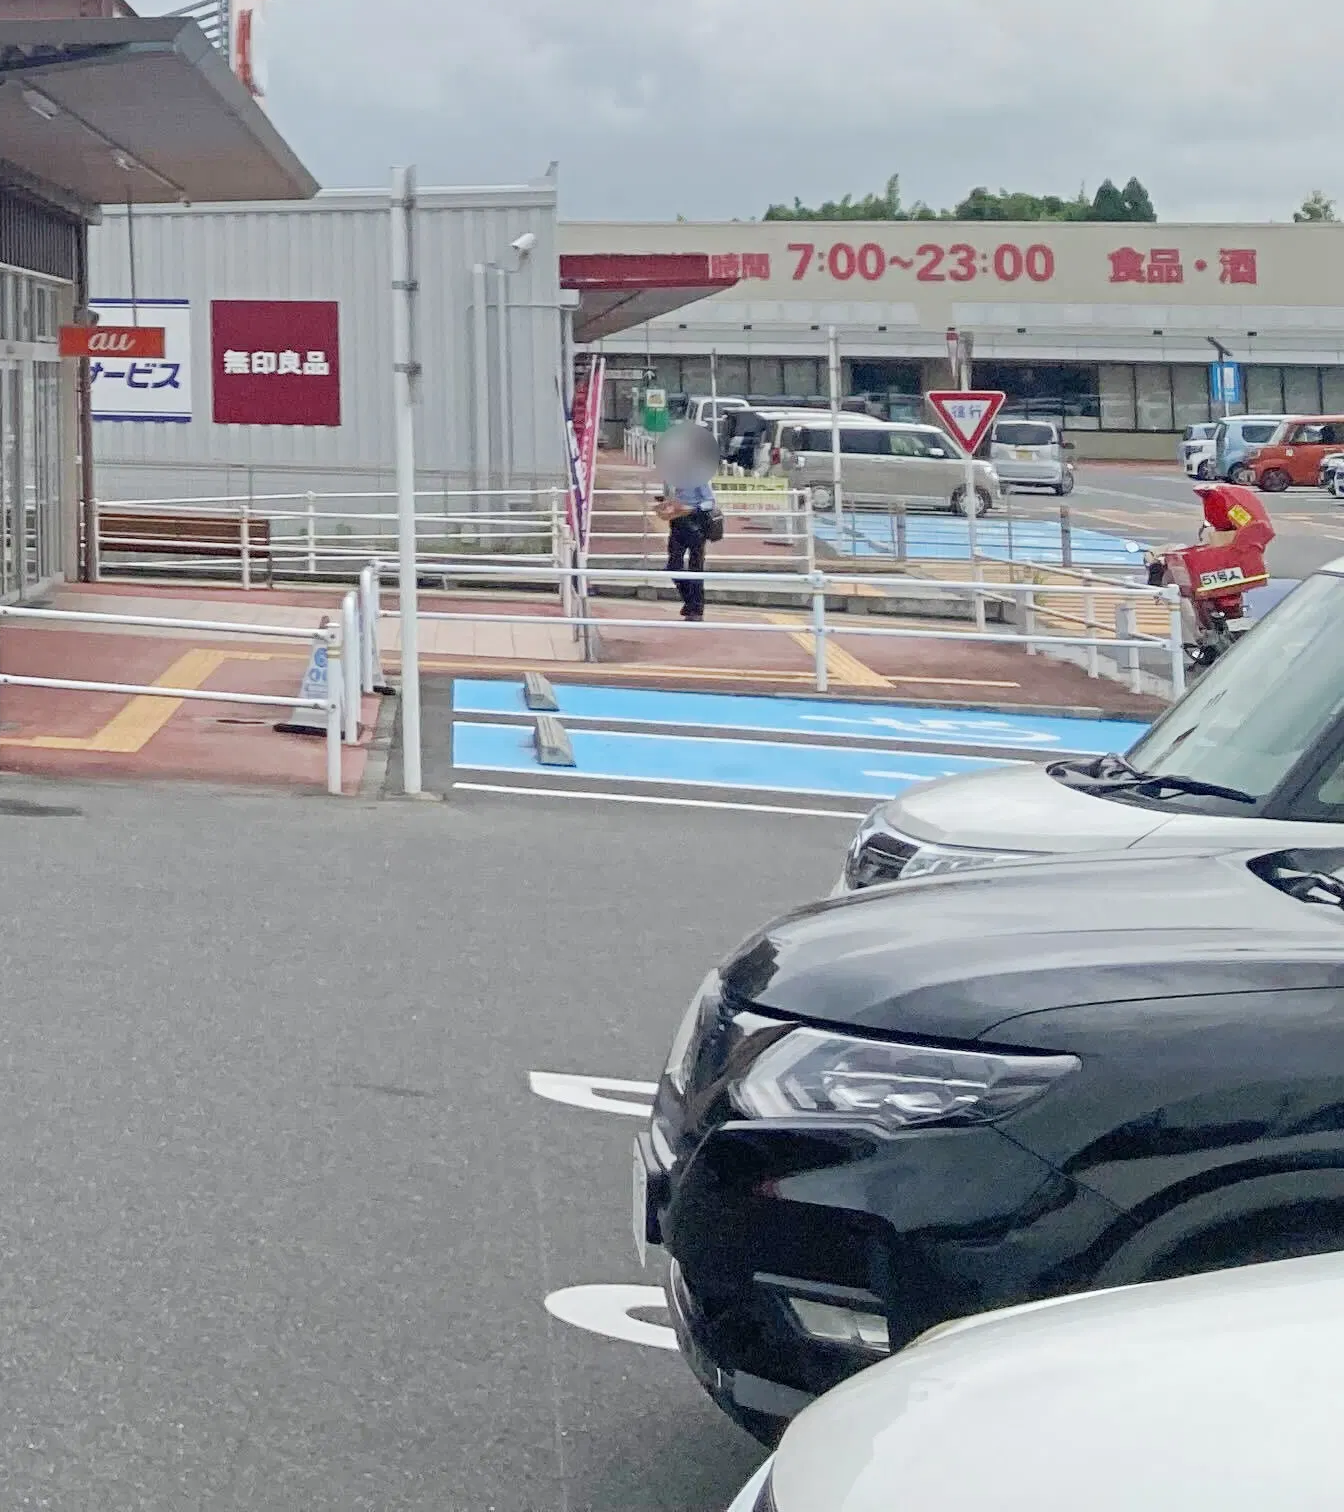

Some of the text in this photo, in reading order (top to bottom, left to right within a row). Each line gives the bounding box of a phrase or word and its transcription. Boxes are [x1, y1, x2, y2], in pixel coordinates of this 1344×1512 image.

[88, 332, 136, 352] au
[224, 350, 330, 376] 無印良品
